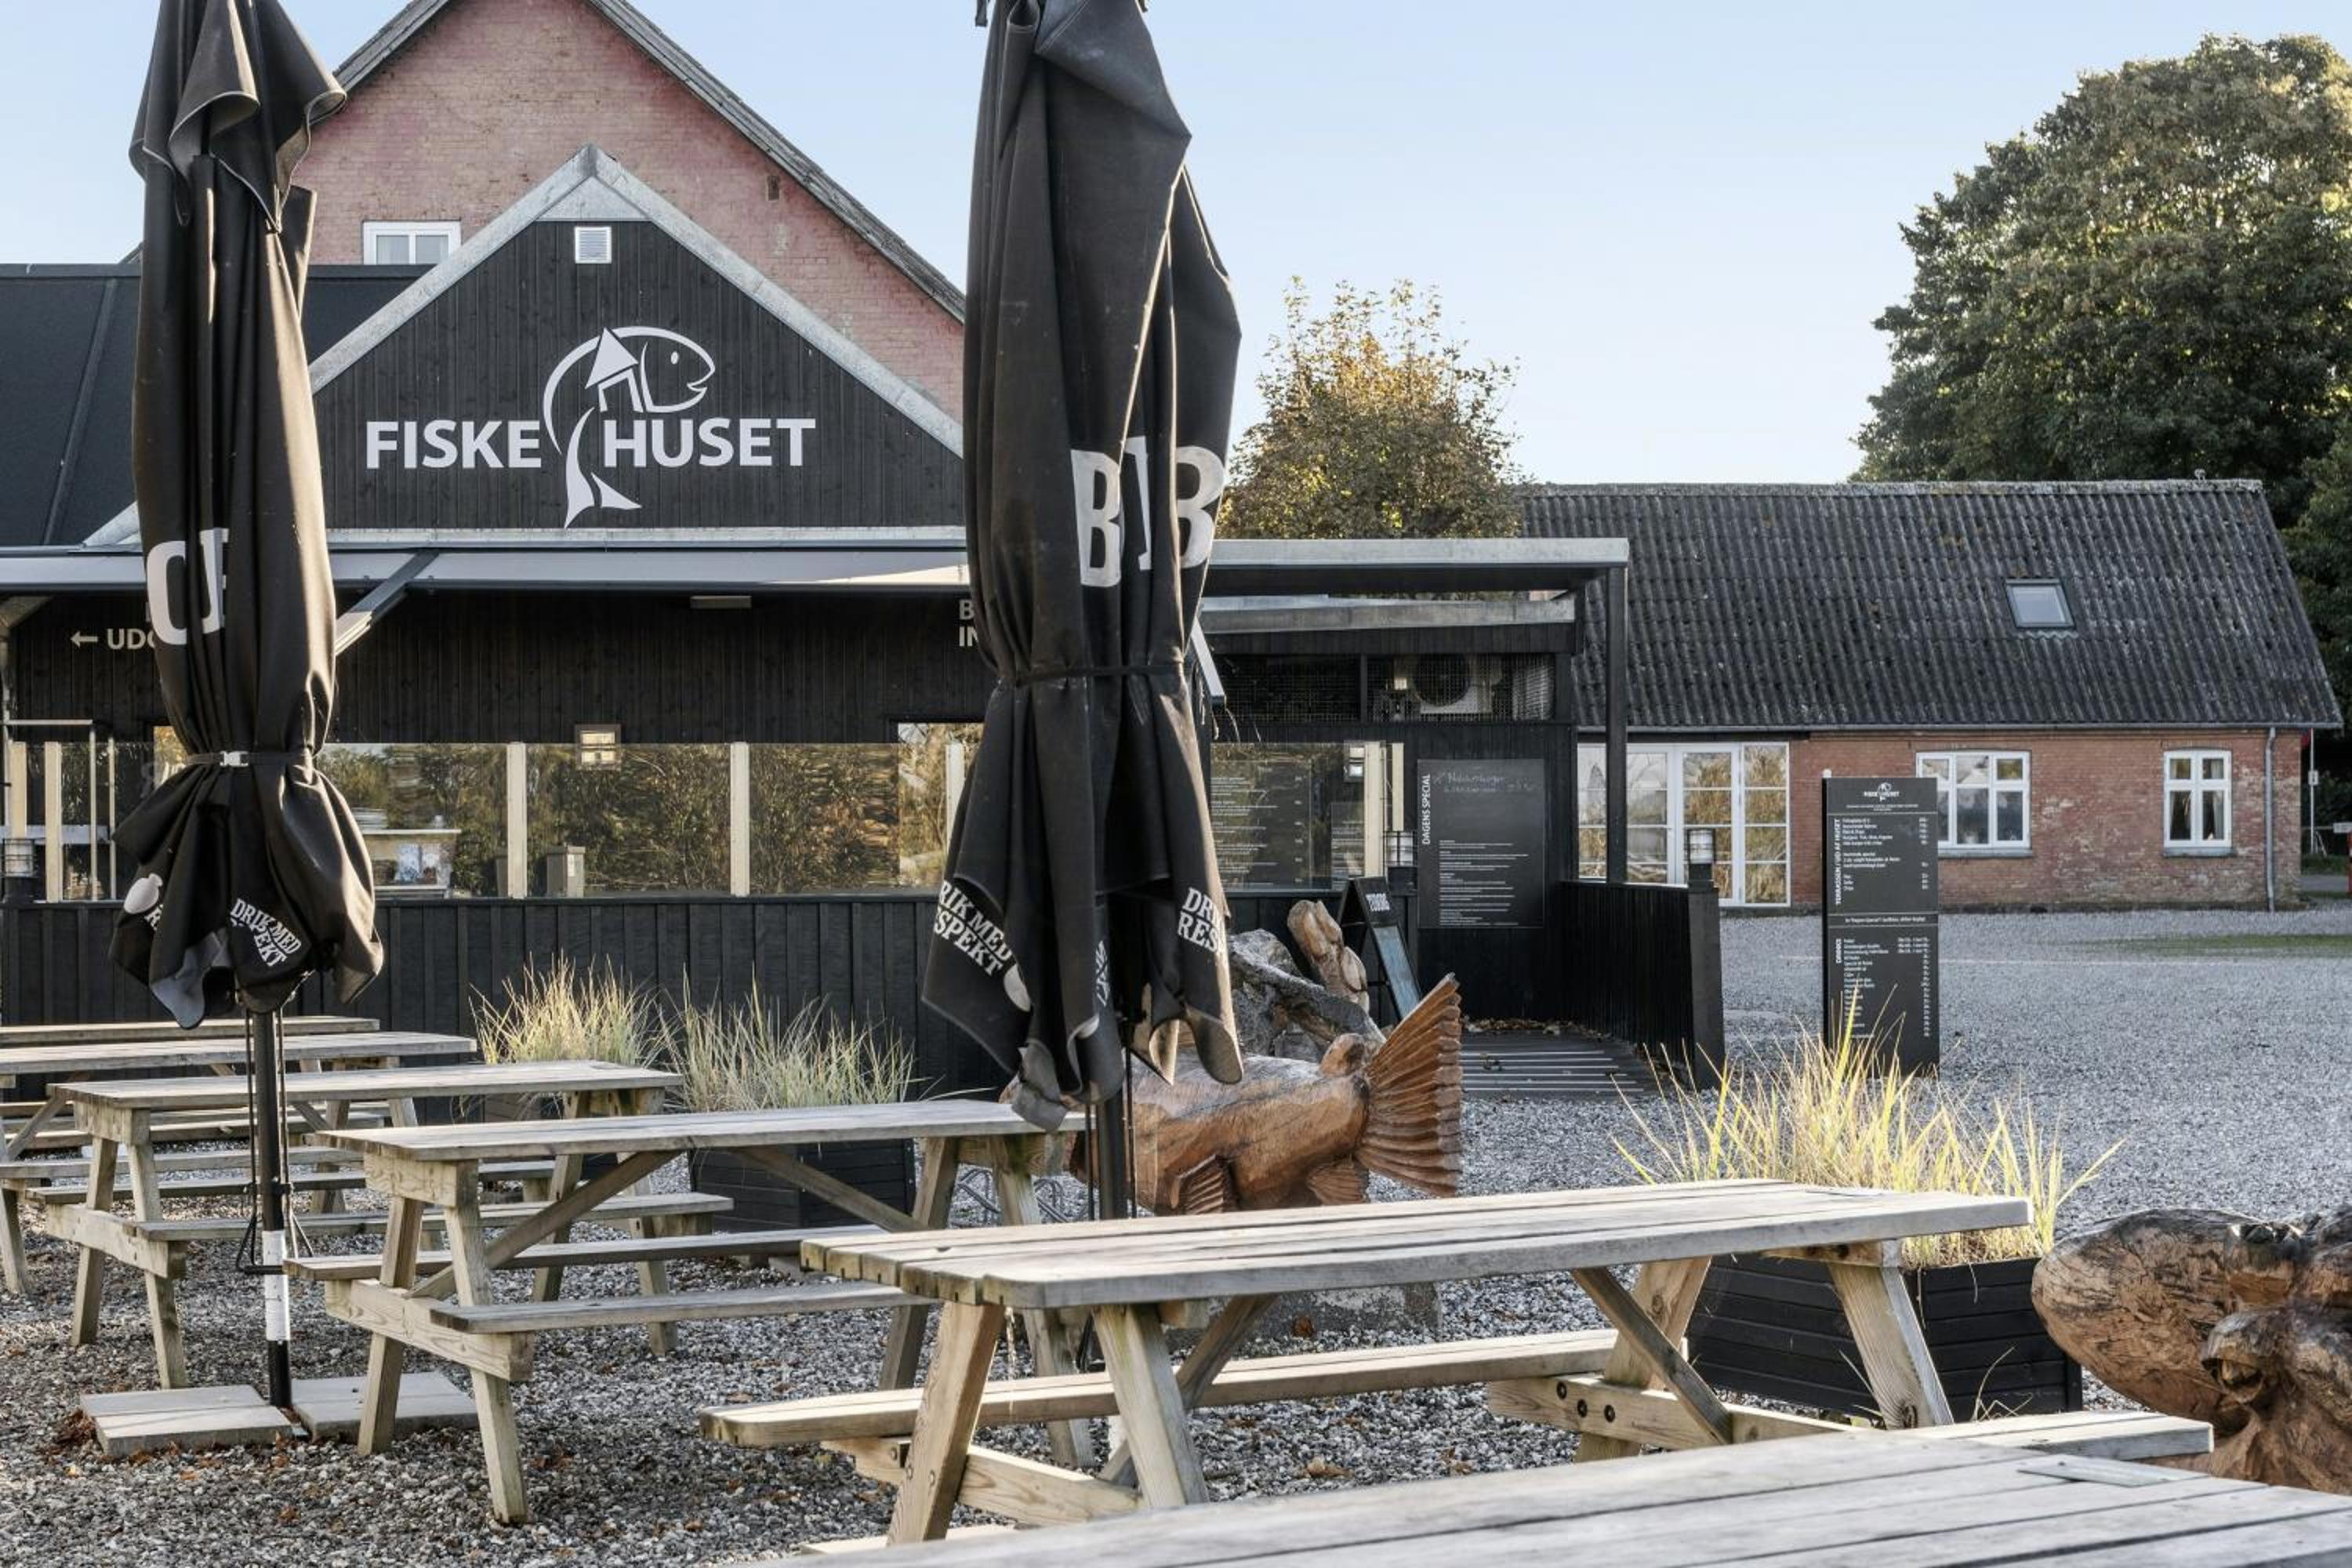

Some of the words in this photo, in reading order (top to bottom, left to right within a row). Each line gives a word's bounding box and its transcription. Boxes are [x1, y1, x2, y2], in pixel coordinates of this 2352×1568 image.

[366, 419, 543, 469] FISKE
[603, 417, 816, 468] HUSET
[1421, 774, 1431, 808] SPECIAL
[1421, 808, 1431, 845] DAGENS
[938, 880, 975, 920] RIK
[269, 921, 301, 953] MED
[934, 905, 1003, 975] SPEKT
